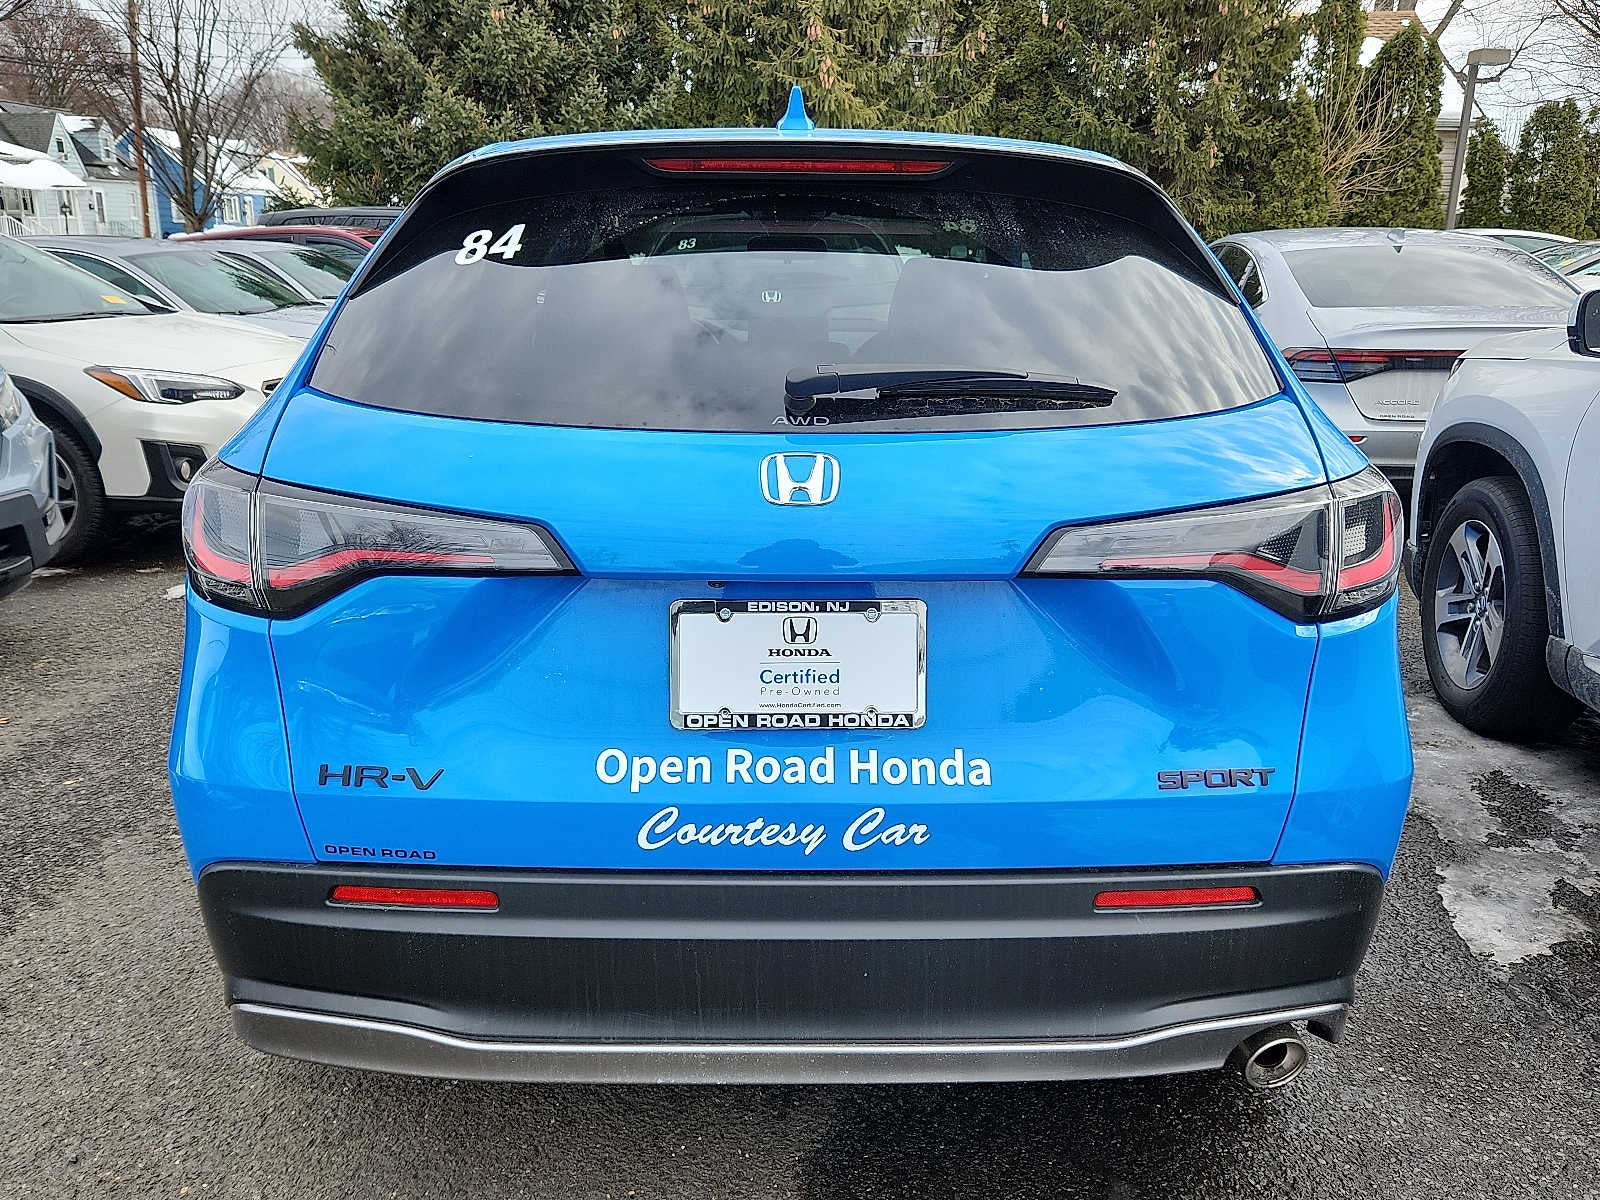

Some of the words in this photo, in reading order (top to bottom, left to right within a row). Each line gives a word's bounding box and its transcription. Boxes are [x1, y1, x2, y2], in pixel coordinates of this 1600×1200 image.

[455, 223, 526, 266] 84
[678, 238, 697, 250] 83
[771, 416, 830, 426] AWD
[747, 601, 820, 613] EDISON,
[826, 601, 850, 612] NJ
[768, 648, 833, 657] HONDA
[759, 668, 840, 685] Certified
[760, 687, 840, 696] Pre-Owned
[686, 713, 749, 728] OPEN
[757, 713, 818, 728] ROAD
[828, 713, 911, 728] HONDA
[318, 763, 445, 791] HR-V
[595, 748, 711, 793] Open
[726, 746, 835, 785] Road
[849, 748, 992, 787] Honda
[1157, 767, 1276, 790] SPORT
[637, 806, 828, 856] Courtesy
[842, 806, 931, 852] Car
[324, 844, 376, 857] OPEN
[381, 847, 437, 860] ROAD
